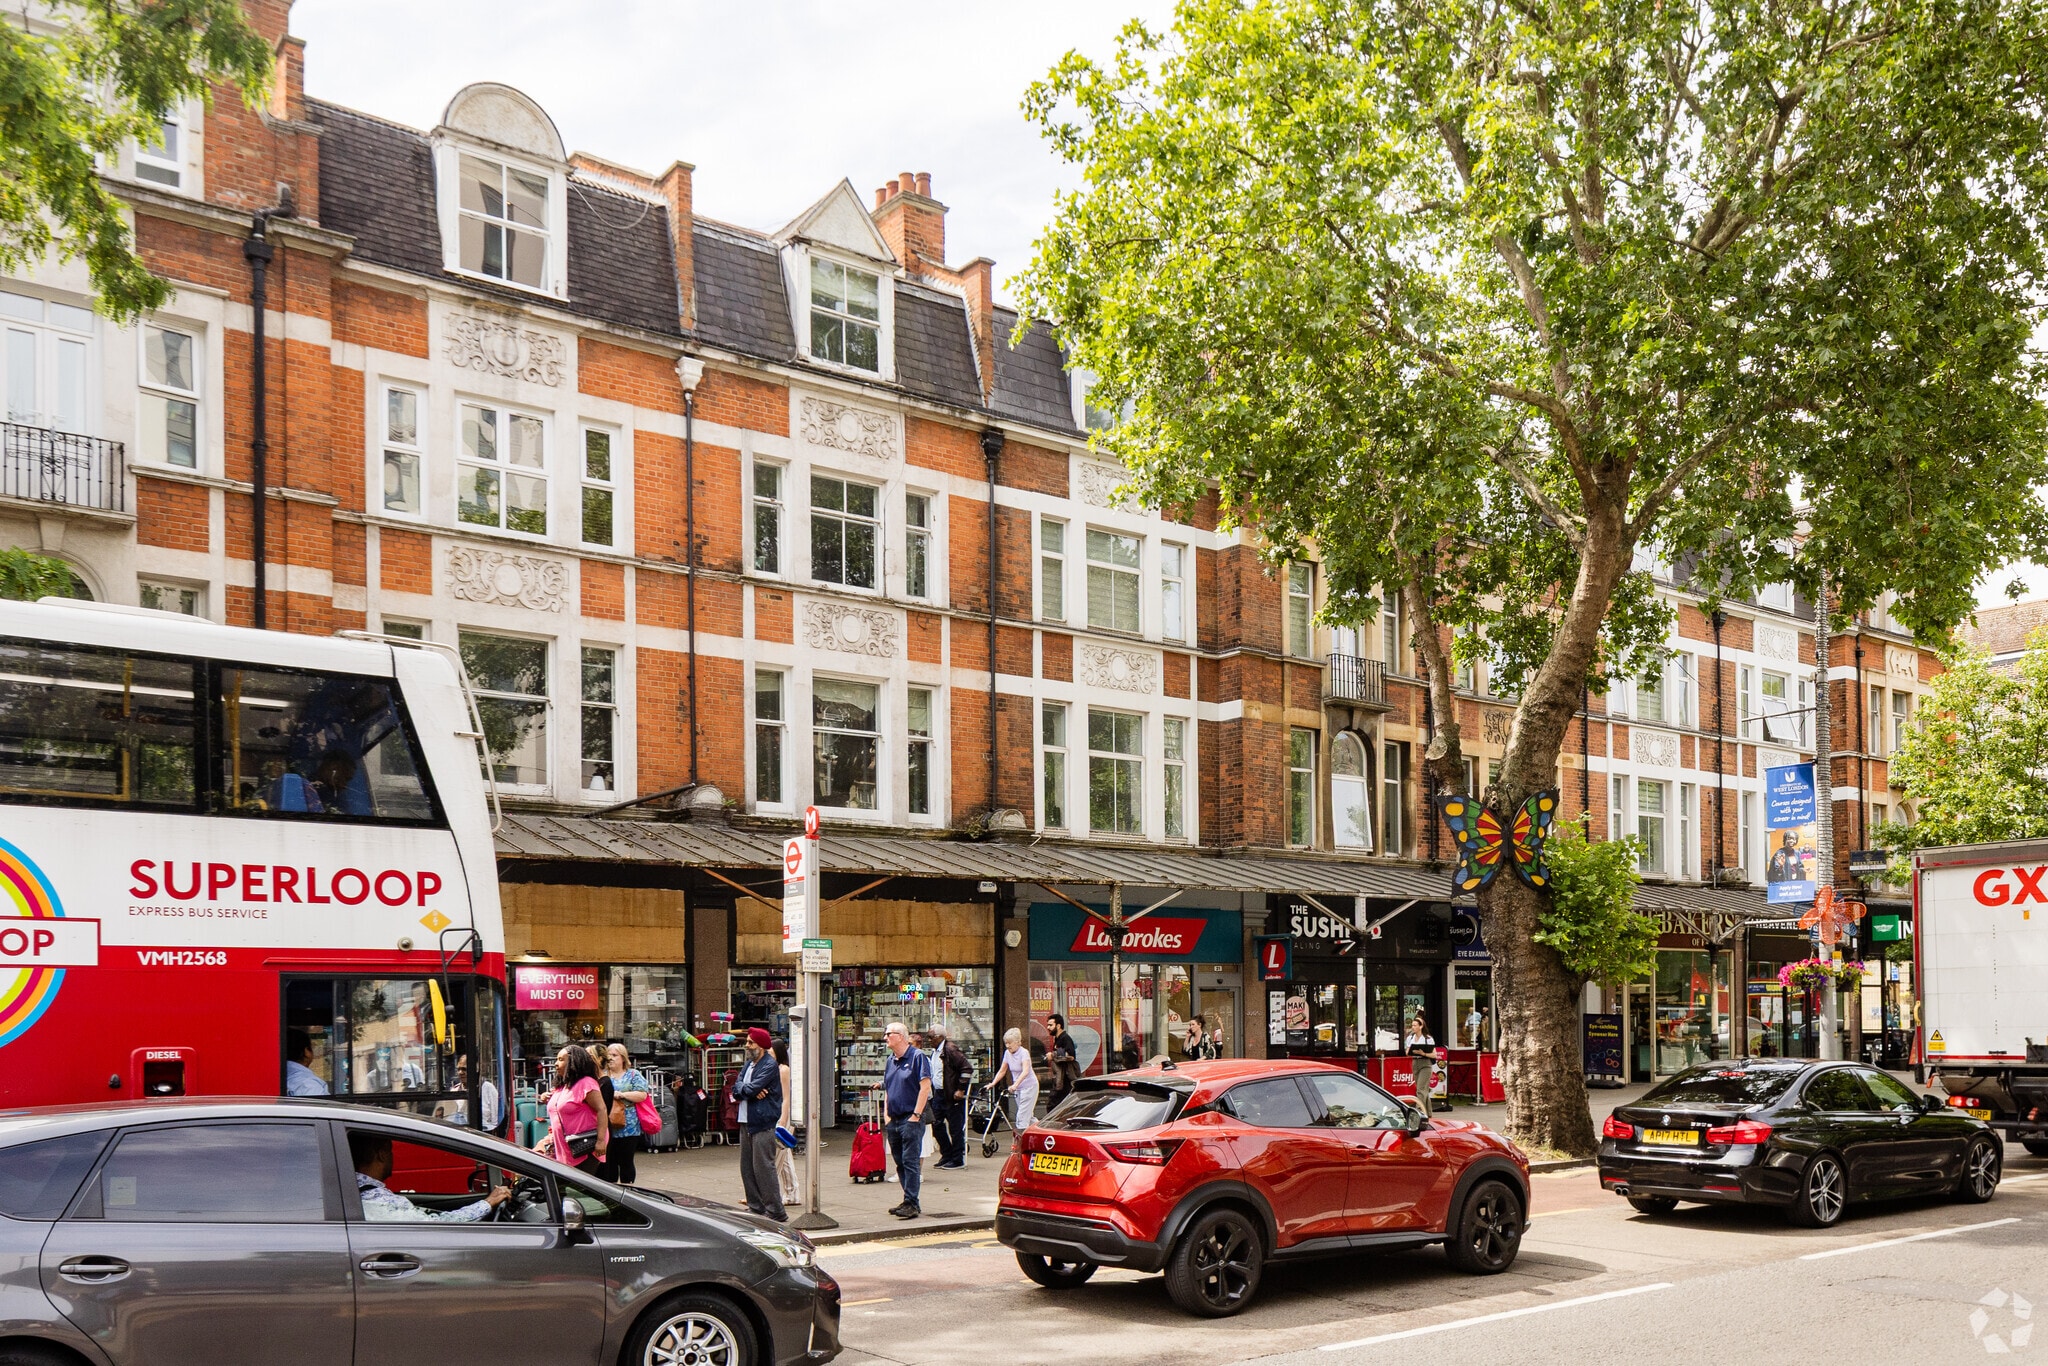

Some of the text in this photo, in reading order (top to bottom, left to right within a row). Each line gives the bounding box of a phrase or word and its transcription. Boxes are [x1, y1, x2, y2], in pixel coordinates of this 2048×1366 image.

[1791, 796, 1812, 806] designed
[806, 810, 816, 831] M
[129, 858, 442, 907] SUPERLOOP
[129, 906, 268, 920] EXPRESS BUS SERVICE
[1290, 905, 1308, 915] THE
[1290, 916, 1350, 938] SUSHI
[1756, 919, 1801, 930] HEAVENL
[1086, 924, 1182, 948] Labrokes
[137, 951, 227, 966] VMH2568
[1268, 944, 1279, 969] L
[519, 974, 594, 985] EVERYTHING
[530, 990, 584, 1000] MUST GO
[898, 992, 924, 1000] mobile
[1034, 988, 1052, 1000] EYES
[1069, 996, 1099, 1007] OF DAILY
[146, 1051, 181, 1060] DIESEL
[1392, 1074, 1413, 1082] SUSHI
[1649, 1130, 1692, 1142] AP17 HTL
[1035, 1155, 1078, 1172] LC25 HFA
